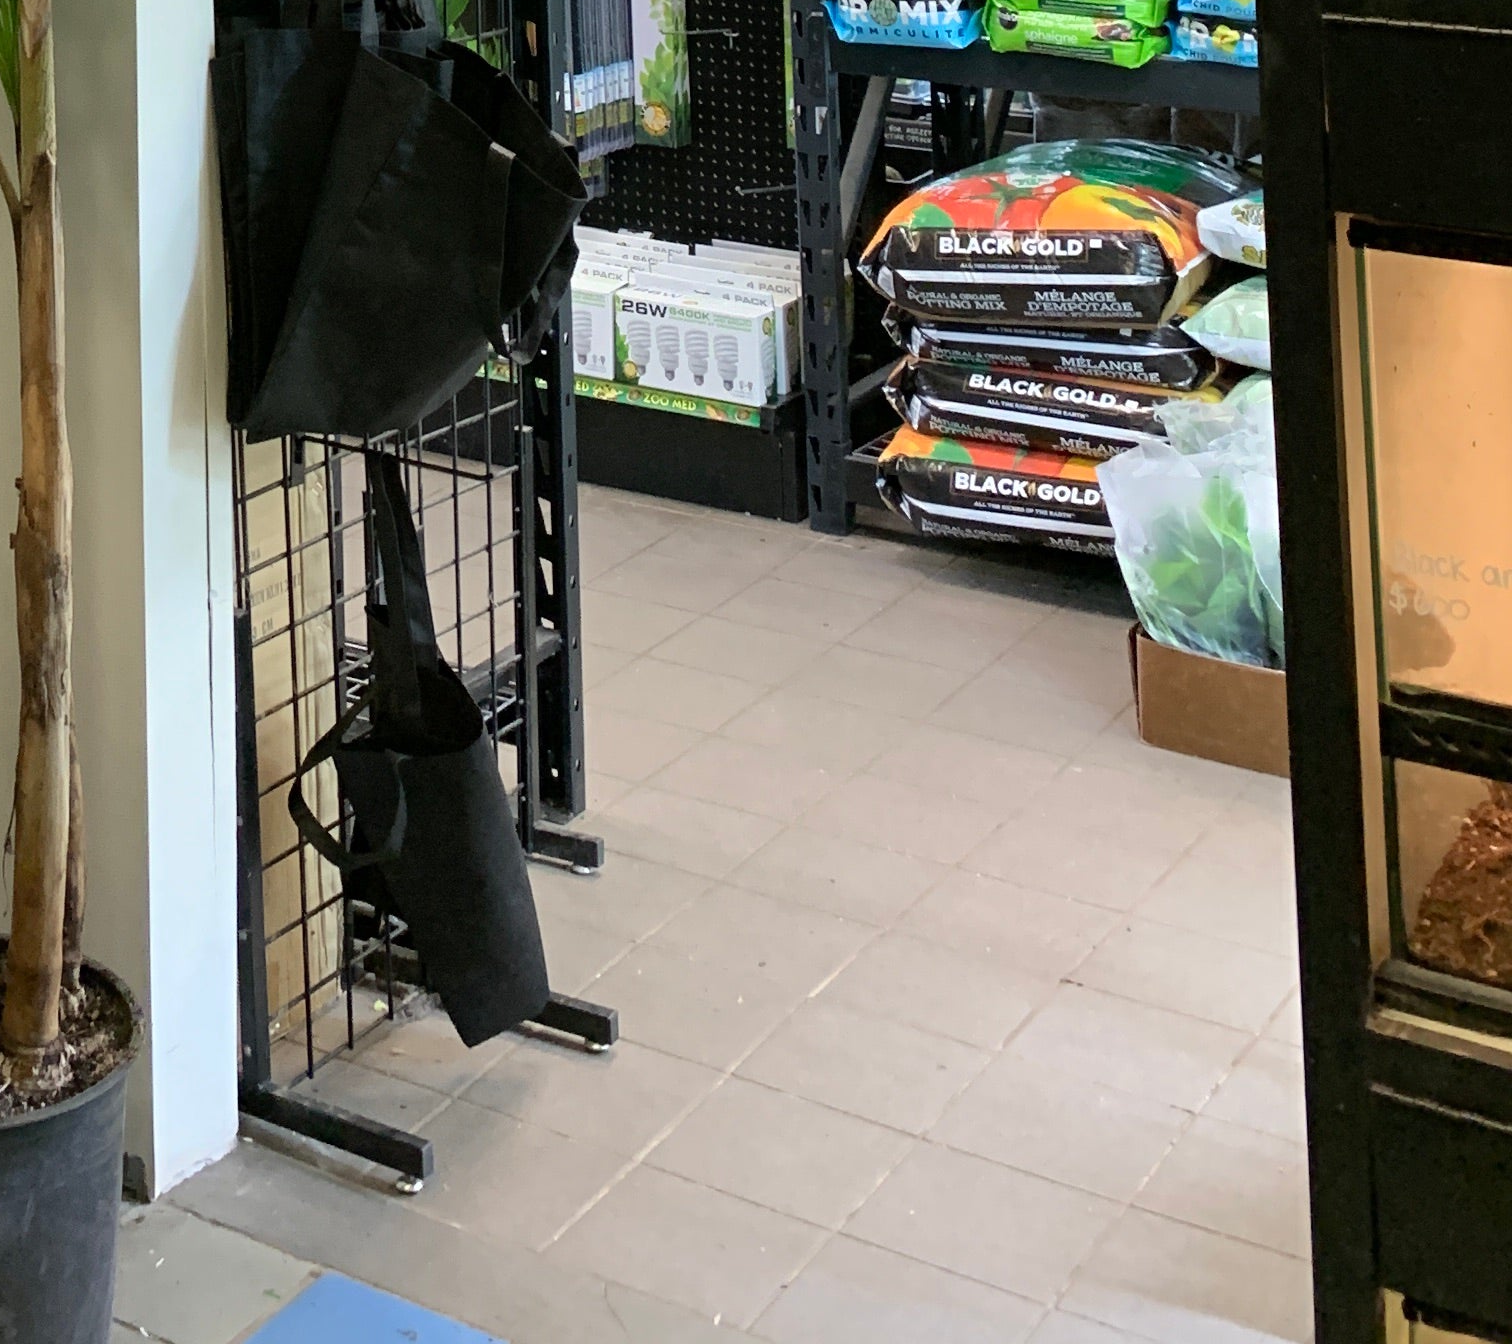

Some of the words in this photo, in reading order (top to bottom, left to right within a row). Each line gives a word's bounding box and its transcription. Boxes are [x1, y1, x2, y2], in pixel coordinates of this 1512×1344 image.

[851, 25, 965, 38] RMICULITE
[1024, 30, 1078, 44] sphaigne
[939, 236, 1013, 256] BLACK
[1021, 237, 1084, 257] GOLD
[581, 267, 589, 277] 4
[592, 270, 624, 282] PACK
[746, 280, 755, 290] 4
[758, 282, 792, 295] PACK
[1034, 288, 1117, 302] MÉLANGE
[722, 292, 731, 301] 4
[735, 295, 768, 308] PACK
[960, 293, 1002, 301] ORGANIC
[975, 298, 1008, 310] MIX
[622, 299, 667, 318] 26W
[1026, 301, 1134, 312] D'EMPOTAGE
[1059, 354, 1145, 373] MÉLANGE
[575, 381, 590, 392] ED
[968, 373, 1043, 398] BLACK
[1053, 385, 1117, 410] GOLD
[643, 392, 670, 407] ZOO
[672, 398, 697, 412] MED
[954, 471, 1029, 498] BLACK
[1038, 483, 1101, 506] GOLD
